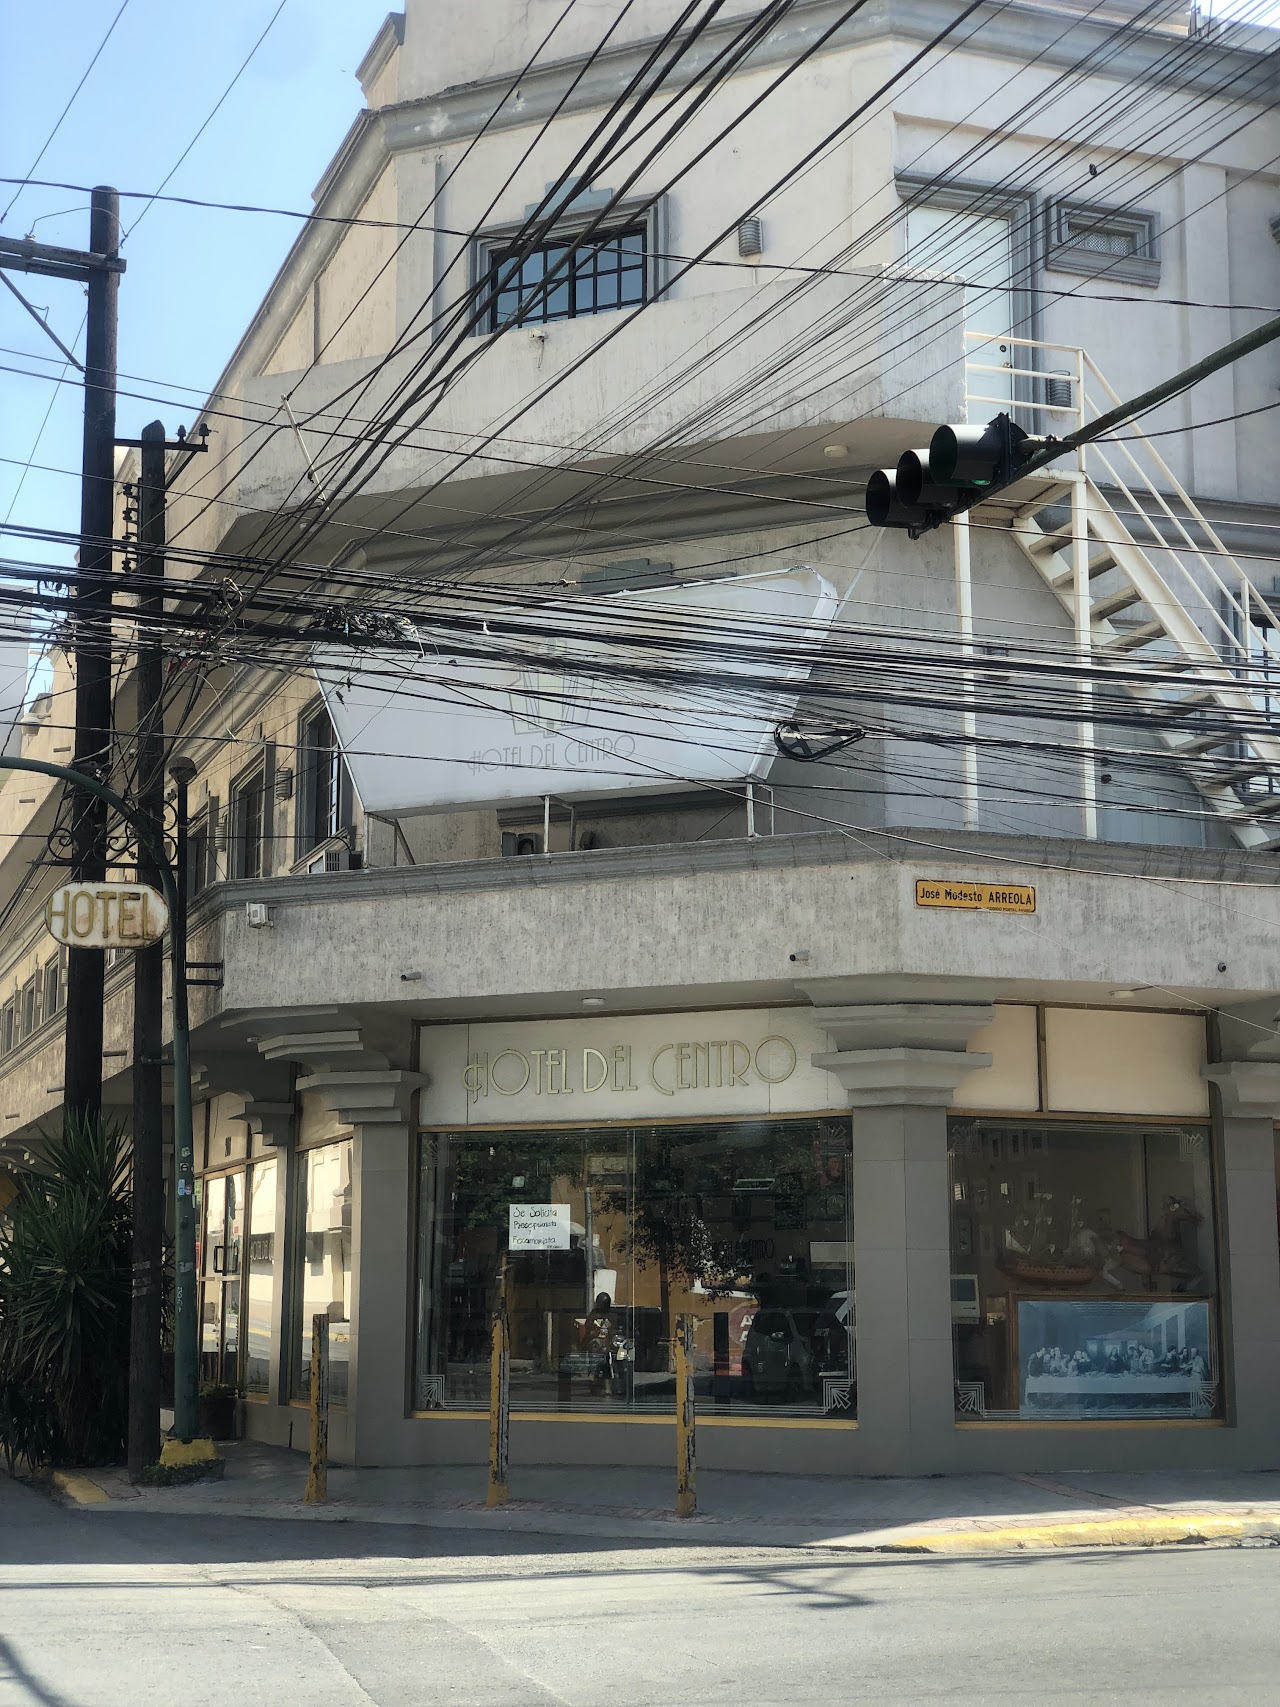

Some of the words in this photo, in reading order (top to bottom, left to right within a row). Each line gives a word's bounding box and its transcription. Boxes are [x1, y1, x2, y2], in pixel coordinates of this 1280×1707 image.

[467, 747, 521, 776] HOTEL
[531, 743, 557, 767] DEL
[565, 734, 636, 766] CENTRO
[47, 890, 157, 940] HOTEL
[920, 887, 940, 899] José
[944, 889, 983, 902] Modesto
[988, 892, 1032, 905] ARREOLA
[462, 1049, 573, 1103] HOTEL
[583, 1045, 638, 1093] DEL
[651, 1035, 797, 1095] CENTRO
[513, 1207, 525, 1218] Se
[529, 1206, 558, 1218] Solicita
